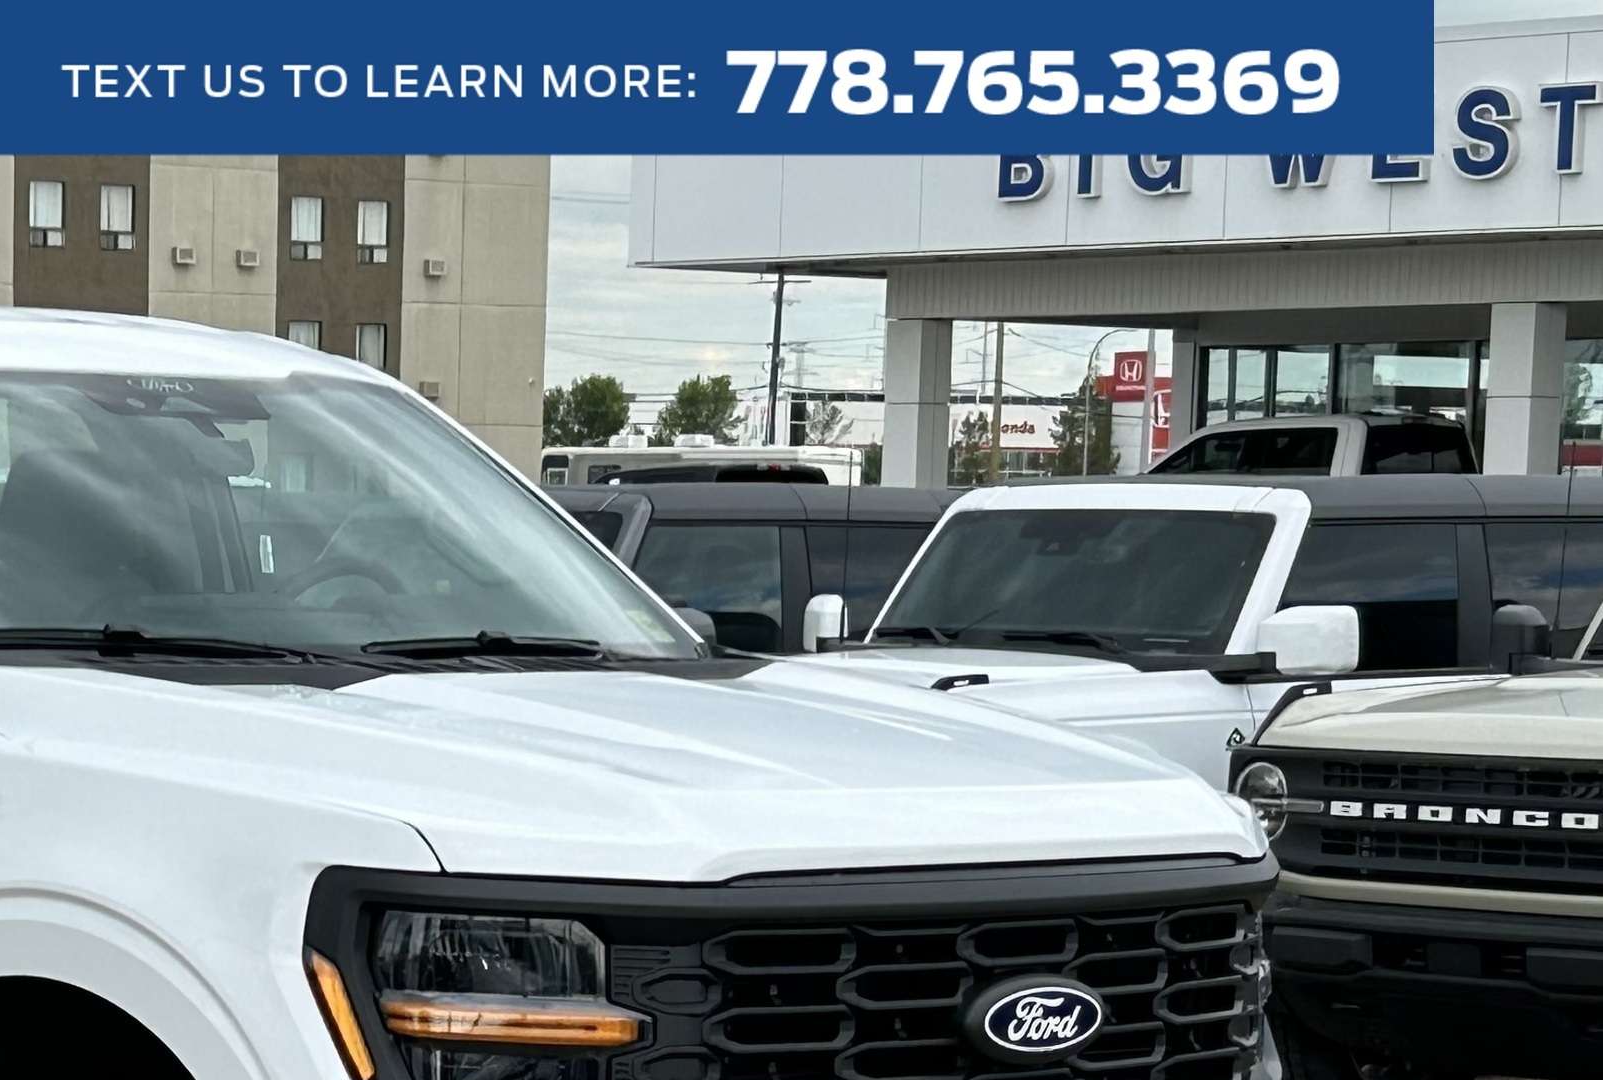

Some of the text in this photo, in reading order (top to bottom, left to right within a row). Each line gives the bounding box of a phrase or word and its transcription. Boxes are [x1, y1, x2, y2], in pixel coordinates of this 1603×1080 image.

[1001, 421, 1035, 434] onda
[1330, 801, 1599, 830] BRONCO
[1007, 996, 1082, 1041] Ford
